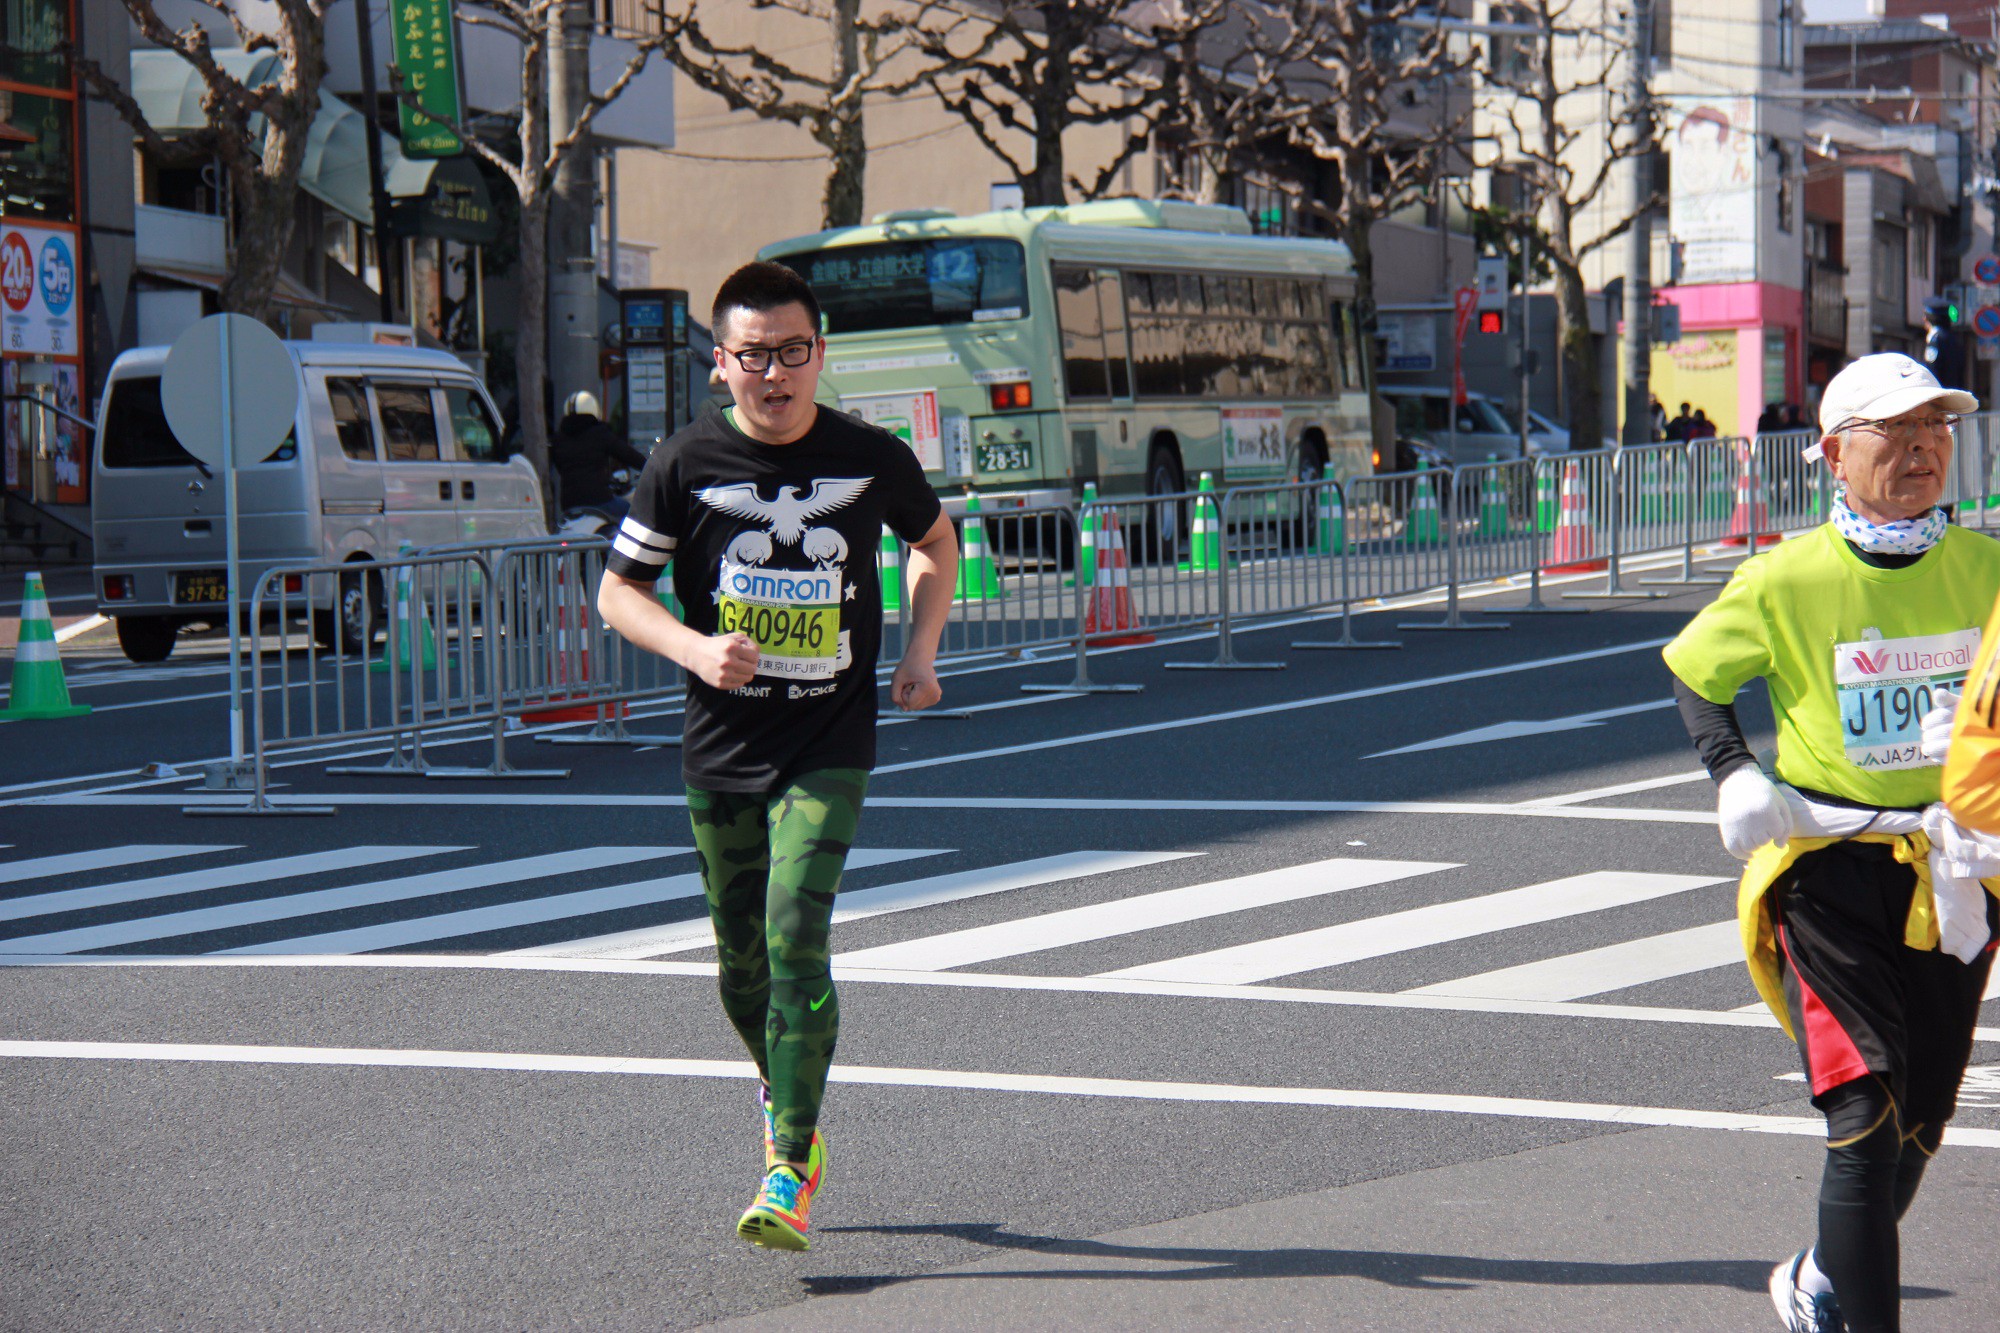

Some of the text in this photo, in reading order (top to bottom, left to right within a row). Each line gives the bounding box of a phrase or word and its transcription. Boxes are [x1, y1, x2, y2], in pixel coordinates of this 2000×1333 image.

[931, 250, 972, 281] 12
[986, 449, 1029, 471] 28-51
[187, 586, 226, 602] 97-82
[722, 600, 823, 649] G40946
[1844, 682, 1869, 690] KYOTO
[1870, 678, 1913, 688] MARATHON
[1848, 679, 1966, 736] J190
